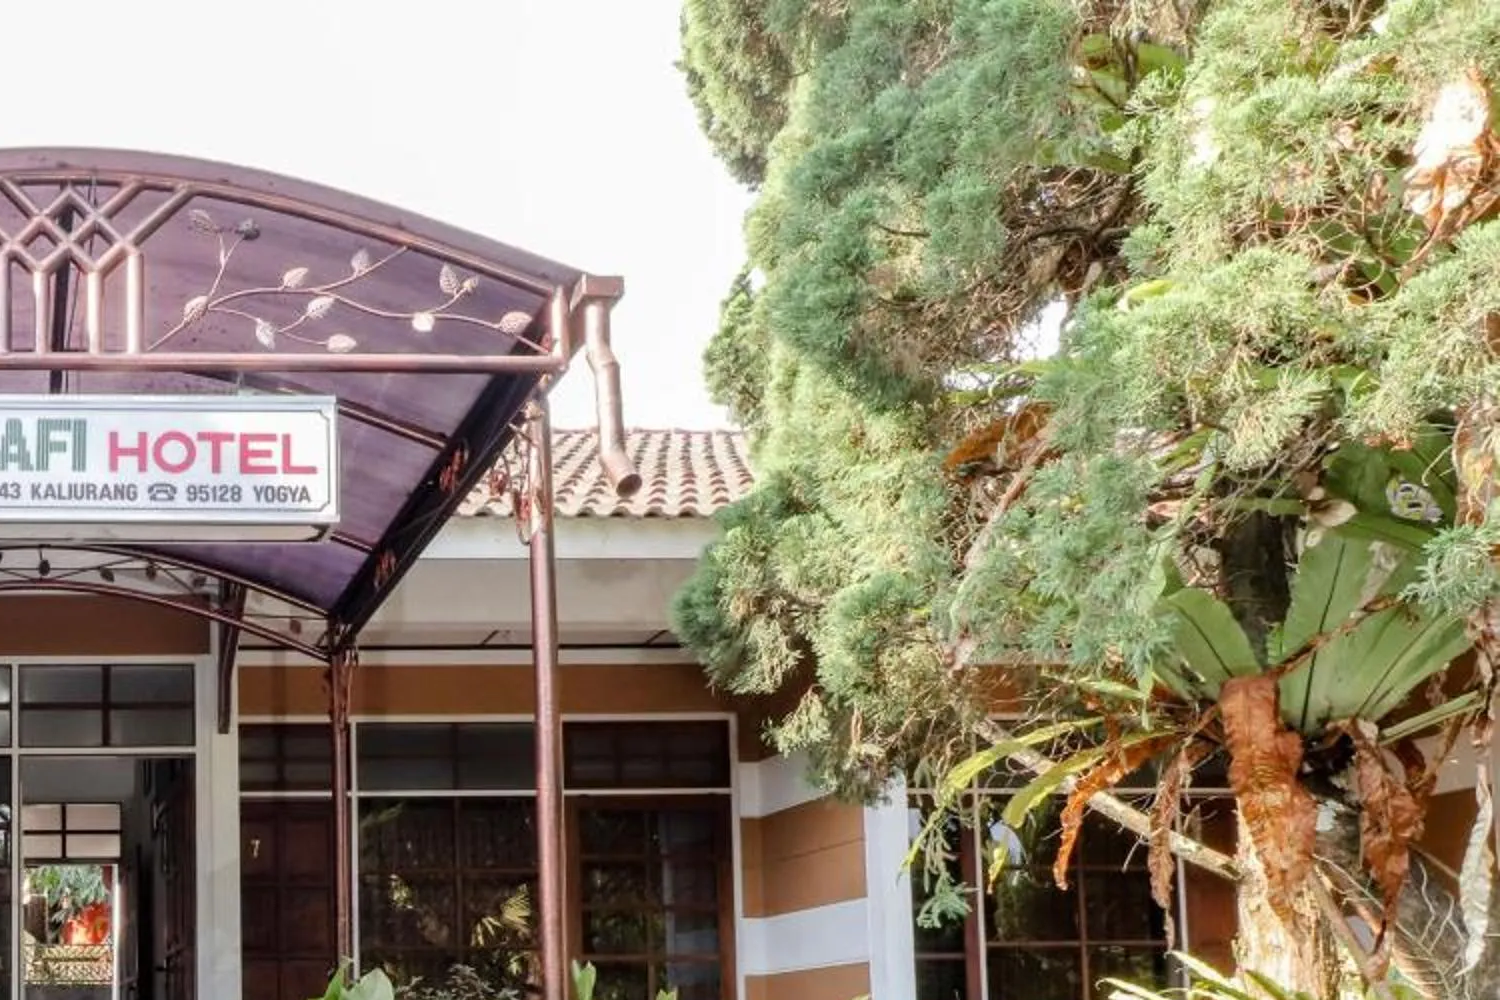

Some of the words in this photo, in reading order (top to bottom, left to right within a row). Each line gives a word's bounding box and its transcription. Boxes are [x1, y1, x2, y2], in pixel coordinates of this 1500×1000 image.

[108, 430, 318, 475] HOTEL
[30, 482, 139, 502] KALIURANG
[185, 484, 243, 502] 95128
[252, 484, 312, 503] YOGYA
